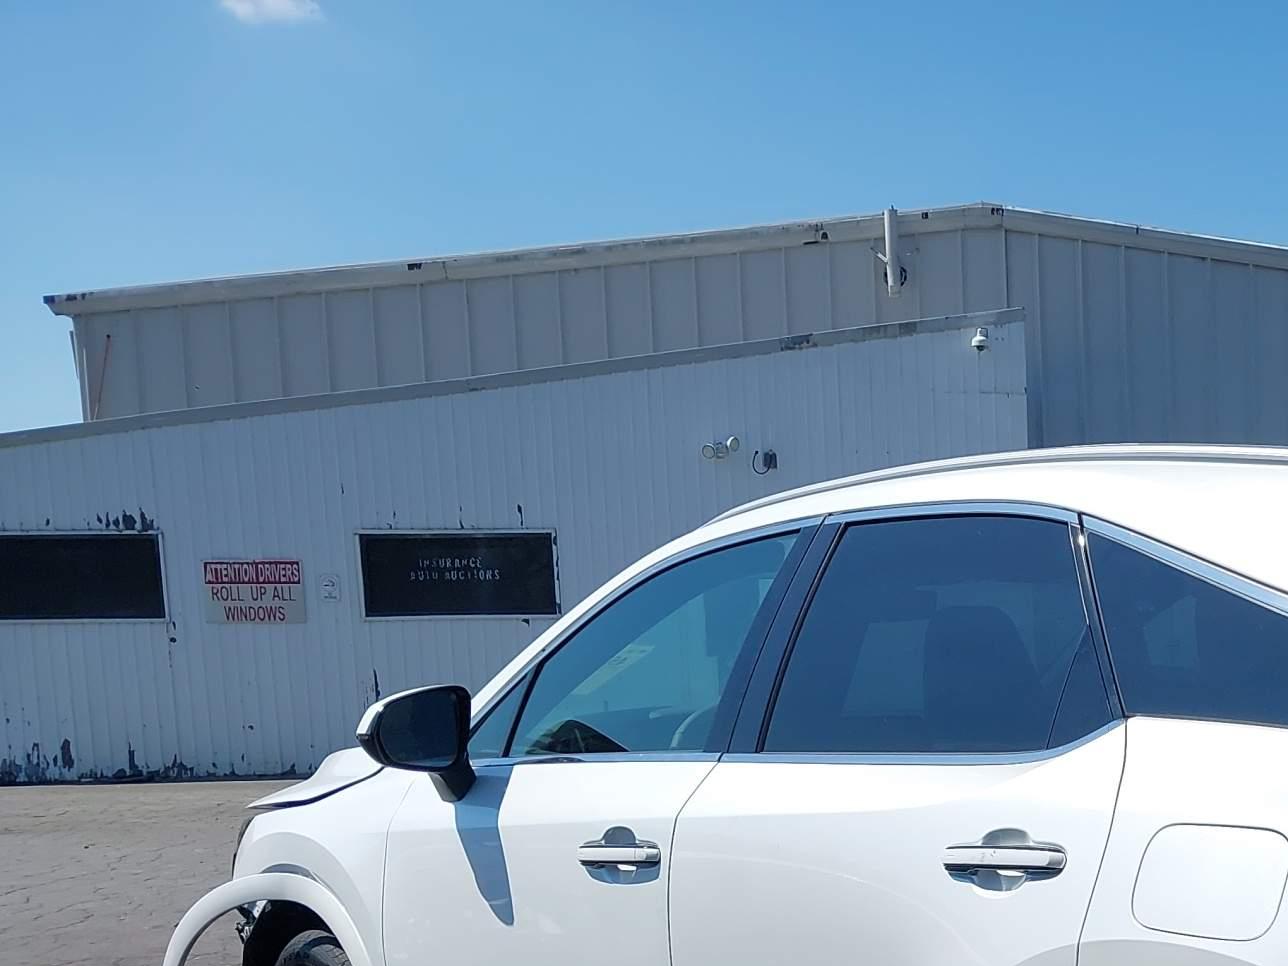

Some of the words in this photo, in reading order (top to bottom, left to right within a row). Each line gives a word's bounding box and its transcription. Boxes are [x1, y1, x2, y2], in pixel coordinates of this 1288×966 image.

[418, 556, 482, 568] INSURANCE
[206, 563, 256, 582] ATTENTION
[258, 563, 299, 582] DRIVERS
[211, 585, 244, 601] ROLL
[249, 585, 267, 601] UP
[272, 585, 297, 601] ALL
[223, 605, 286, 622] WINDOWS
